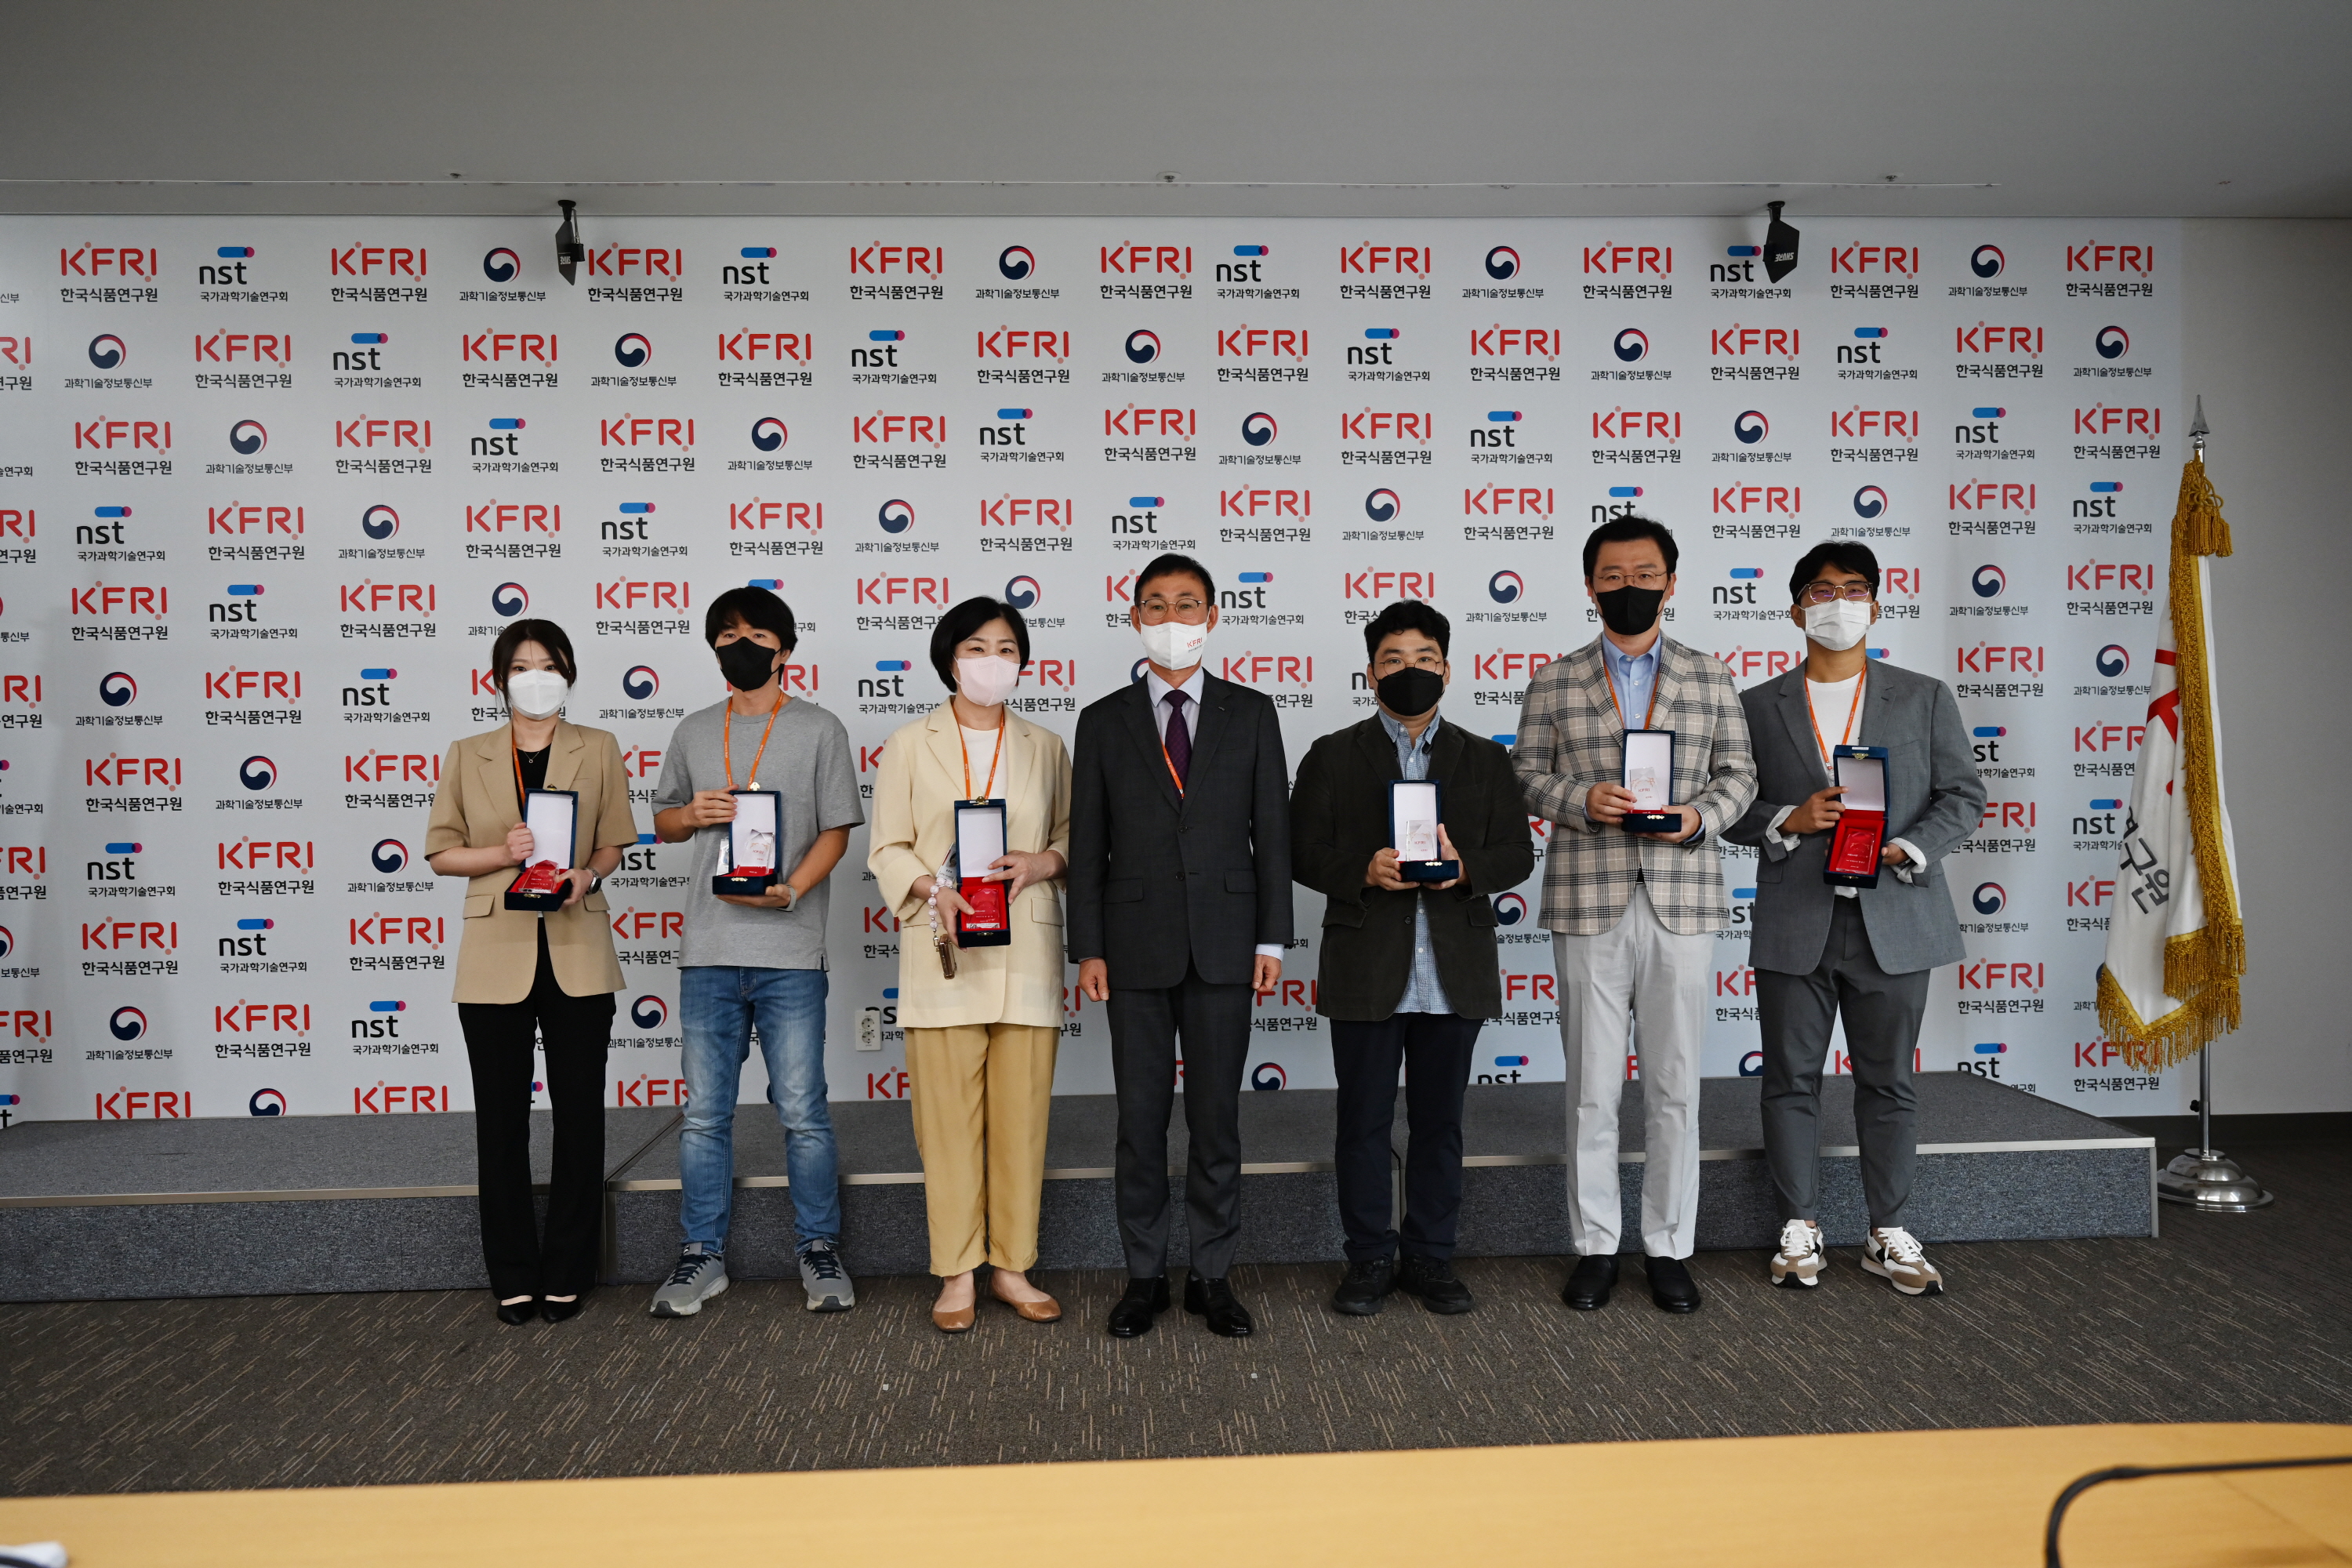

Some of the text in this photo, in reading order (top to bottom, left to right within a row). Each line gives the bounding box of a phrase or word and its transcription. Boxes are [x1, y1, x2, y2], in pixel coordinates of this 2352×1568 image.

[331, 248, 427, 276] KFRI
[1100, 246, 1192, 274] KFRI
[1584, 246, 1672, 274] KFRI
[1774, 252, 1795, 263] SHURE
[1831, 246, 1918, 274] KFRI
[2067, 245, 2153, 272] KFRI
[198, 261, 248, 285] nst
[723, 262, 770, 285] nst
[1216, 260, 1261, 283] nst
[1710, 260, 1755, 283] nst
[200, 291, 289, 303] 국가과학기술연구회
[459, 291, 546, 303] 과학기술정보통신부
[587, 287, 683, 303] 한국식품연구원
[724, 290, 809, 302] 국가과학기술연구회
[849, 285, 943, 300] 한국식품연구원
[975, 289, 1060, 299] 과학기술정보통신부
[1216, 288, 1300, 299] 국가과학기술연구회
[1339, 285, 1431, 299] 한국식품연구원
[1461, 288, 1544, 299] 과학기술정보통신부
[1582, 285, 1672, 299] 한국식품연구원
[1710, 288, 1791, 299] 국가과학기술연구회
[1830, 284, 1918, 299] 한국식품연구원
[1947, 286, 2028, 297] 과학기술정보통신부
[463, 334, 558, 361] KFRI
[718, 333, 812, 361] KFRI
[1218, 329, 1308, 357] KFRI
[1471, 328, 1561, 356] KFRI
[1956, 326, 2043, 353] KFRI
[332, 347, 381, 371] nst
[851, 344, 898, 368] nst
[1347, 342, 1392, 365] nst
[1837, 341, 1881, 364] nst
[851, 373, 937, 385] 국가과학기술연구회
[977, 368, 1070, 384] 한국식품연구원
[1102, 372, 1185, 383] 과학기술정보통신부
[1217, 367, 1308, 383] 한국식품연구원
[1348, 371, 1430, 382] 국가과학기술연구회
[1470, 366, 1560, 382] 한국식품연구원
[1591, 370, 1672, 381] 과학기술정보통신부
[1837, 369, 1918, 380] 국가과학기술연구회
[1955, 364, 2043, 379] 한국식품연구원
[2073, 367, 2152, 378] 과학기술정보통신부
[64, 378, 153, 389] 과학기술정보통신부
[333, 376, 422, 388] 국가과학기술연구회
[462, 372, 558, 388] 한국식품연구원
[590, 376, 677, 387] 과학기술정보통신부
[1341, 412, 1432, 440] KFRI
[1831, 410, 1918, 437] KFRI
[2074, 408, 2161, 434] KFRI
[336, 419, 431, 448] KFRI
[601, 419, 695, 446] KFRI
[979, 423, 1025, 446] nst
[1470, 425, 1515, 448] nst
[1955, 421, 1999, 444] nst
[470, 433, 519, 456] nst
[2073, 445, 2161, 459] 한국식품연구원
[980, 451, 1065, 463] 국가과학기술연구회
[1104, 446, 1196, 462] 한국식품연구원
[1218, 455, 1301, 466] 과학기술정보통신부
[1341, 450, 1432, 465] 한국식품연구원
[1470, 453, 1552, 464] 국가과학기술연구회
[1591, 448, 1681, 464] 한국식품연구원
[1711, 452, 1792, 463] 과학기술정보통신부
[1955, 448, 2035, 460] 국가과학기술연구회
[205, 463, 294, 474] 과학기술정보통신부
[335, 459, 432, 474] 한국식품연구원
[471, 461, 559, 474] 국가과학기술연구회
[600, 457, 695, 473] 한국식품연구원
[728, 459, 813, 471] 과학기술정보통신부
[1220, 489, 1311, 517] KFRI
[1465, 488, 1554, 515] KFRI
[1949, 483, 2036, 510] KFRI
[2073, 495, 2116, 518] nst
[208, 506, 304, 535] KFRI
[730, 502, 823, 530] KFRI
[1112, 510, 1158, 534] nst
[76, 521, 125, 545] nst
[601, 517, 648, 540] nst
[1219, 528, 1311, 543] 한국식품연구원
[1341, 530, 1425, 541] 과학기술정보통신부
[1711, 524, 1801, 539] 한국식품연구원
[1831, 527, 1911, 538] 과학기술정보통신부
[1947, 521, 2036, 535] 한국식품연구원
[2073, 523, 2152, 535] 국가과학기술연구회
[465, 543, 561, 559] 한국식품연구원
[602, 546, 688, 557] 국가과학기술연구회
[729, 540, 823, 557] 한국식품연구원
[855, 542, 940, 553] 과학기술정보통신부
[1112, 539, 1196, 551] 국가과학기술연구회
[77, 550, 165, 562] 국가과학기술연구회
[338, 548, 426, 560] 과학기술정보통신부
[2067, 564, 2154, 590] KFRI
[857, 577, 949, 605] KFRI
[1345, 572, 1435, 599] KFRI
[1712, 582, 1757, 604] nst
[71, 586, 168, 615] KFRI
[340, 584, 436, 612] KFRI
[596, 581, 690, 609] KFRI
[1220, 585, 1267, 610] nst
[209, 599, 257, 622] nst
[1949, 605, 2029, 617] 과학기술정보통신부
[2066, 601, 2153, 615] 한국식품연구원
[1221, 614, 1304, 626] 국가과학기술연구회
[1465, 612, 1548, 622] 과학기술정보통신부
[71, 626, 169, 641] 한국식품연구원
[209, 627, 298, 640] 국가과학기술연구회
[339, 622, 436, 638] 한국식품연구원
[595, 619, 690, 636] 한국식품연구원
[1186, 637, 1203, 648] KFRI
[1958, 646, 2044, 673] KFRI
[1222, 655, 1313, 684] KFRI
[205, 670, 302, 699] KFRI
[858, 674, 905, 698] nst
[1956, 683, 2044, 699] 한국식품연구원
[342, 683, 390, 706] nst
[75, 715, 164, 727] 과학기술정보통신부
[205, 710, 302, 726] 한국식품연구원
[343, 711, 430, 724] 국가과학기술연구회
[599, 708, 684, 720] 과학기술정보통신부
[85, 757, 182, 786] KFRI
[345, 754, 441, 782] KFRI
[85, 797, 183, 813] 한국식품연구원
[215, 798, 303, 810] 과학기술정보통신부
[2072, 811, 2116, 836] nst
[218, 840, 314, 870] KFRI
[87, 857, 136, 880] nst
[88, 885, 176, 898] 국가과학기술연구회
[217, 880, 314, 896] 한국식품연구원
[347, 881, 434, 893] 과학기술정보통신부
[82, 921, 178, 950] KFRI
[350, 916, 445, 946] KFRI
[219, 933, 267, 956] nst
[81, 960, 179, 977] 한국식품연구원
[220, 961, 307, 974] 국가과학기술연구회
[349, 955, 445, 971] 한국식품연구원
[1958, 962, 2044, 989] KFRI
[1957, 999, 2044, 1014] 한국식품연구원
[215, 1004, 310, 1033] KFRI
[351, 1014, 399, 1039] nst
[85, 1049, 173, 1061] 과학기술정보통신부
[214, 1042, 311, 1059] 한국식품연구원
[352, 1043, 439, 1056] 국가과학기술연구회
[2074, 1076, 2160, 1091] 한국식품연구원
[96, 1091, 192, 1119] KFRI
[354, 1085, 449, 1112] KFRI
